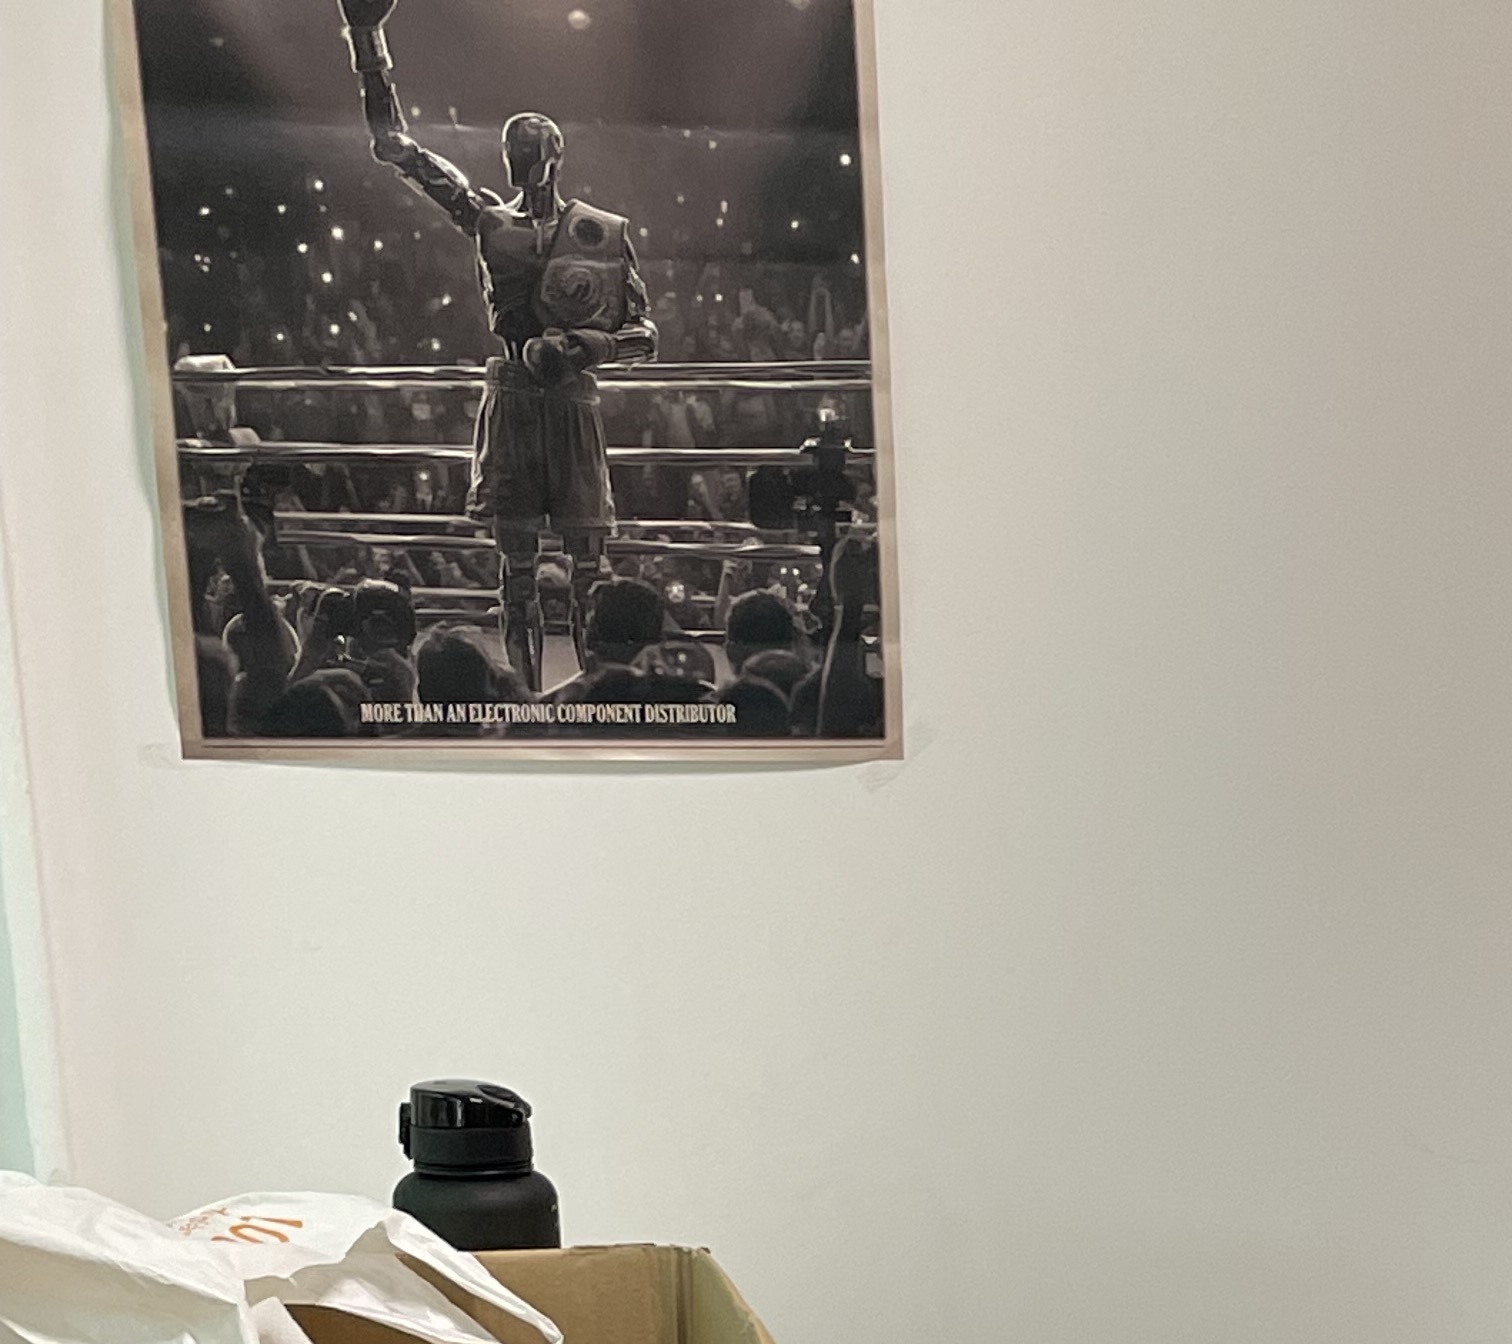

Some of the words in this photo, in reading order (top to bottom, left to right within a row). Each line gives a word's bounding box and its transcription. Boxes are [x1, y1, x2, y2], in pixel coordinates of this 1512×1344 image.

[361, 703, 400, 722] MORE
[405, 703, 444, 722] THAN
[447, 703, 467, 722] AN
[469, 703, 555, 723] ELECTRONIC
[557, 703, 642, 723] COMPONENT
[644, 703, 736, 723] DISTRIBUTOR
